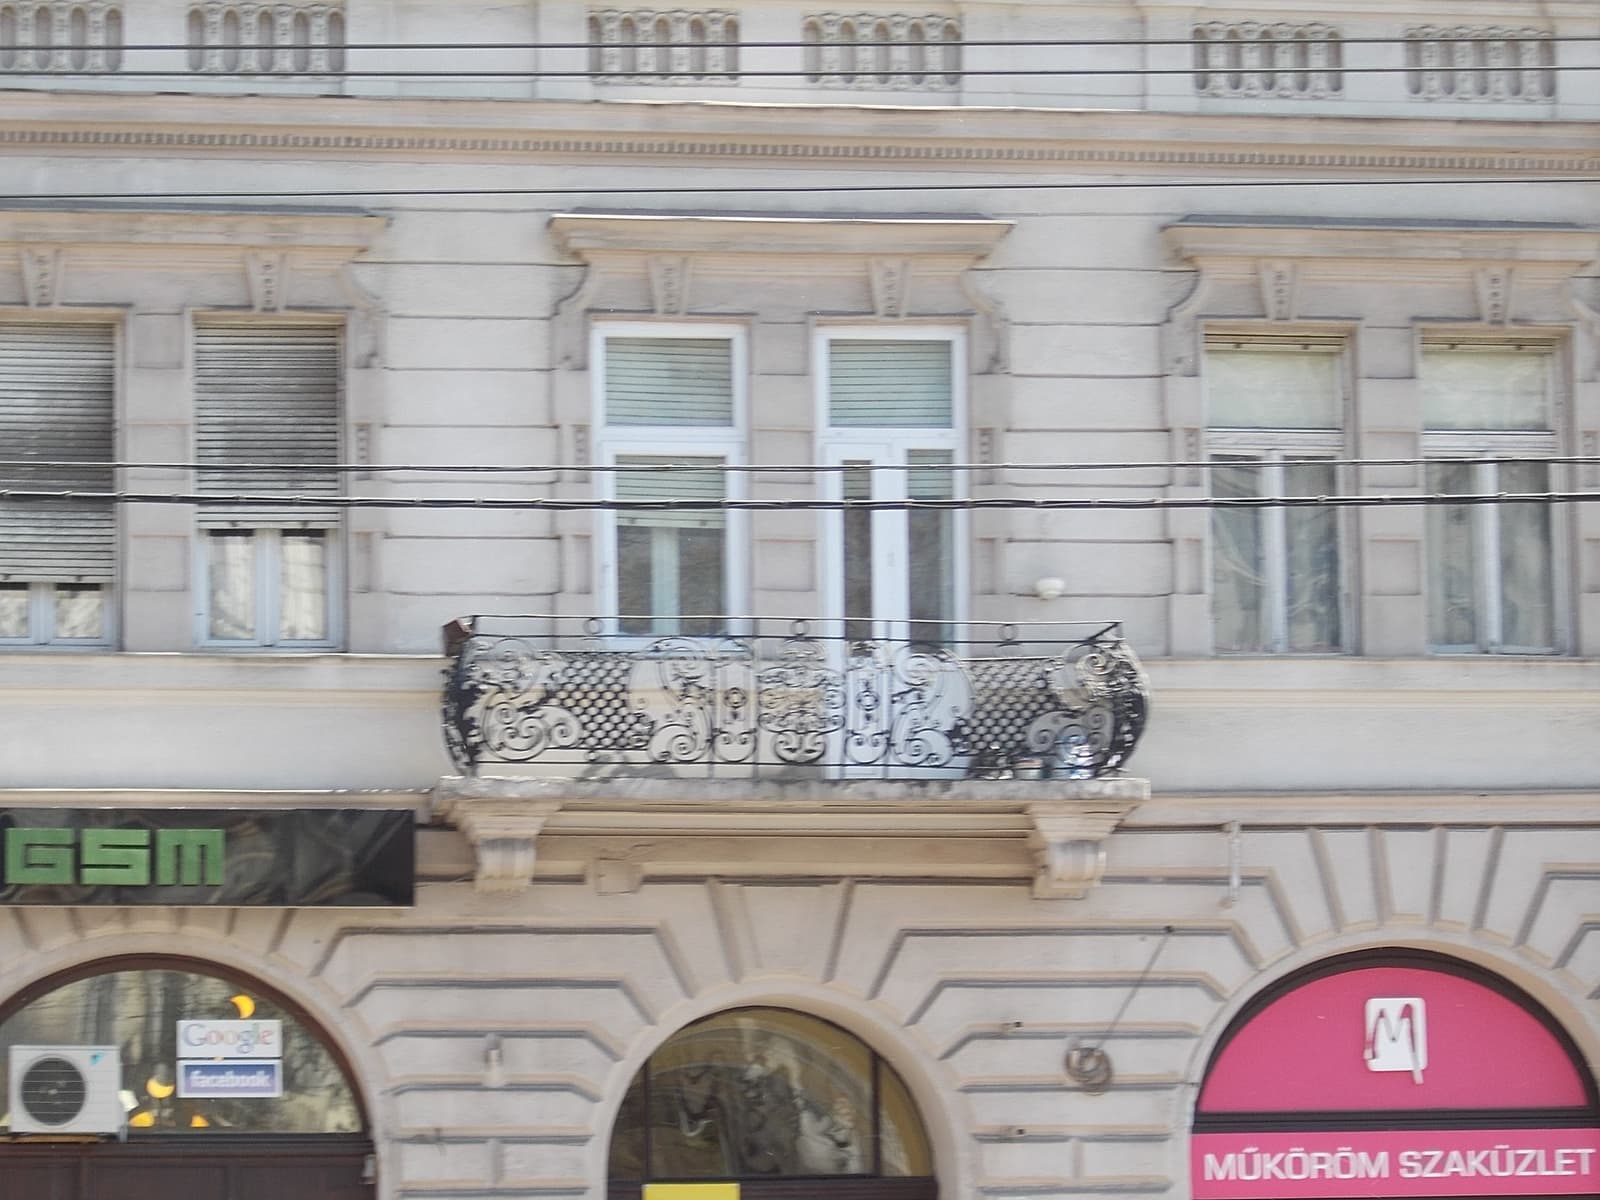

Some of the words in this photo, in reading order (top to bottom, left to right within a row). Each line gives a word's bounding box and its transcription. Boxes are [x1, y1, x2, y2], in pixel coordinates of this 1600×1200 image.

[5, 827, 226, 886] GSM
[183, 1023, 274, 1055] Google
[189, 1070, 272, 1089] facebook
